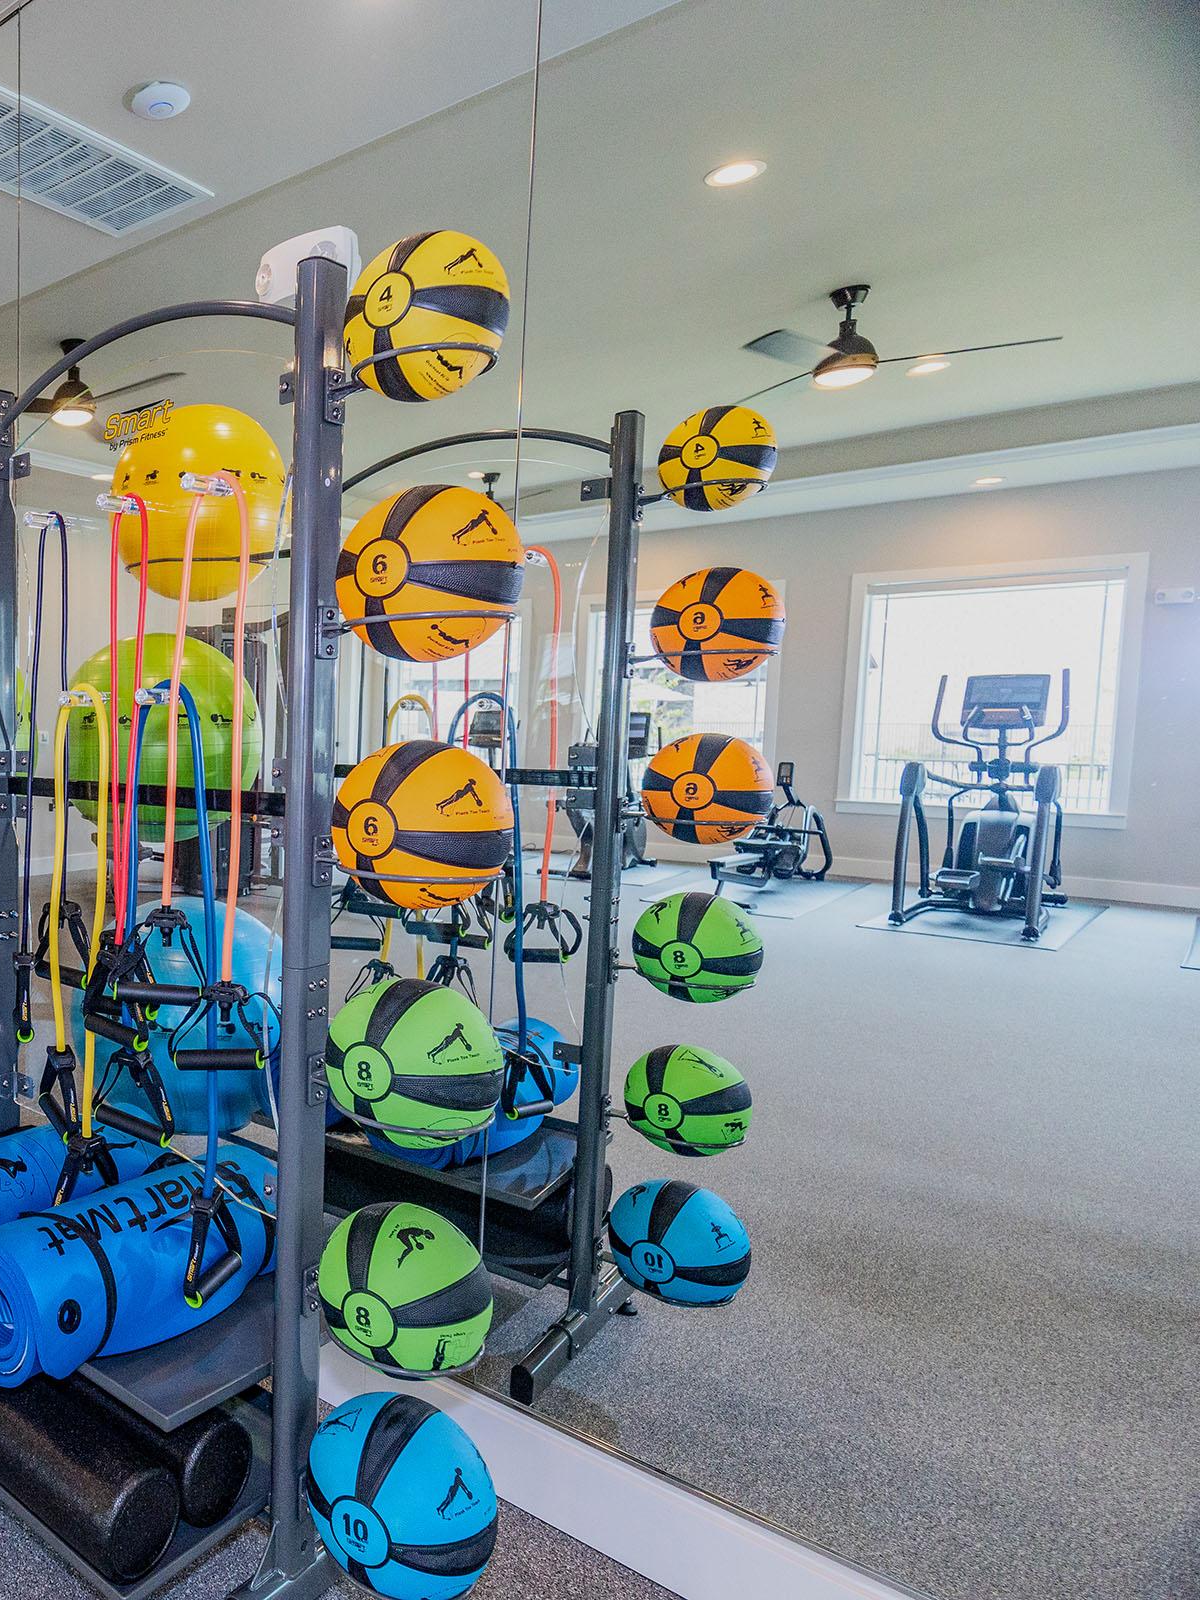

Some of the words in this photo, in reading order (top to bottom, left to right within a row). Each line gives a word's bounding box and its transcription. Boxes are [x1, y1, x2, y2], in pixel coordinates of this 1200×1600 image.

[379, 285, 392, 303] 4
[104, 399, 174, 440] Smart
[109, 442, 118, 451] by
[119, 437, 139, 448] Prism
[371, 554, 388, 575] 6
[363, 816, 378, 836] 6
[357, 1061, 372, 1081] 8
[355, 1306, 371, 1327] 8
[342, 1512, 369, 1544] 10
